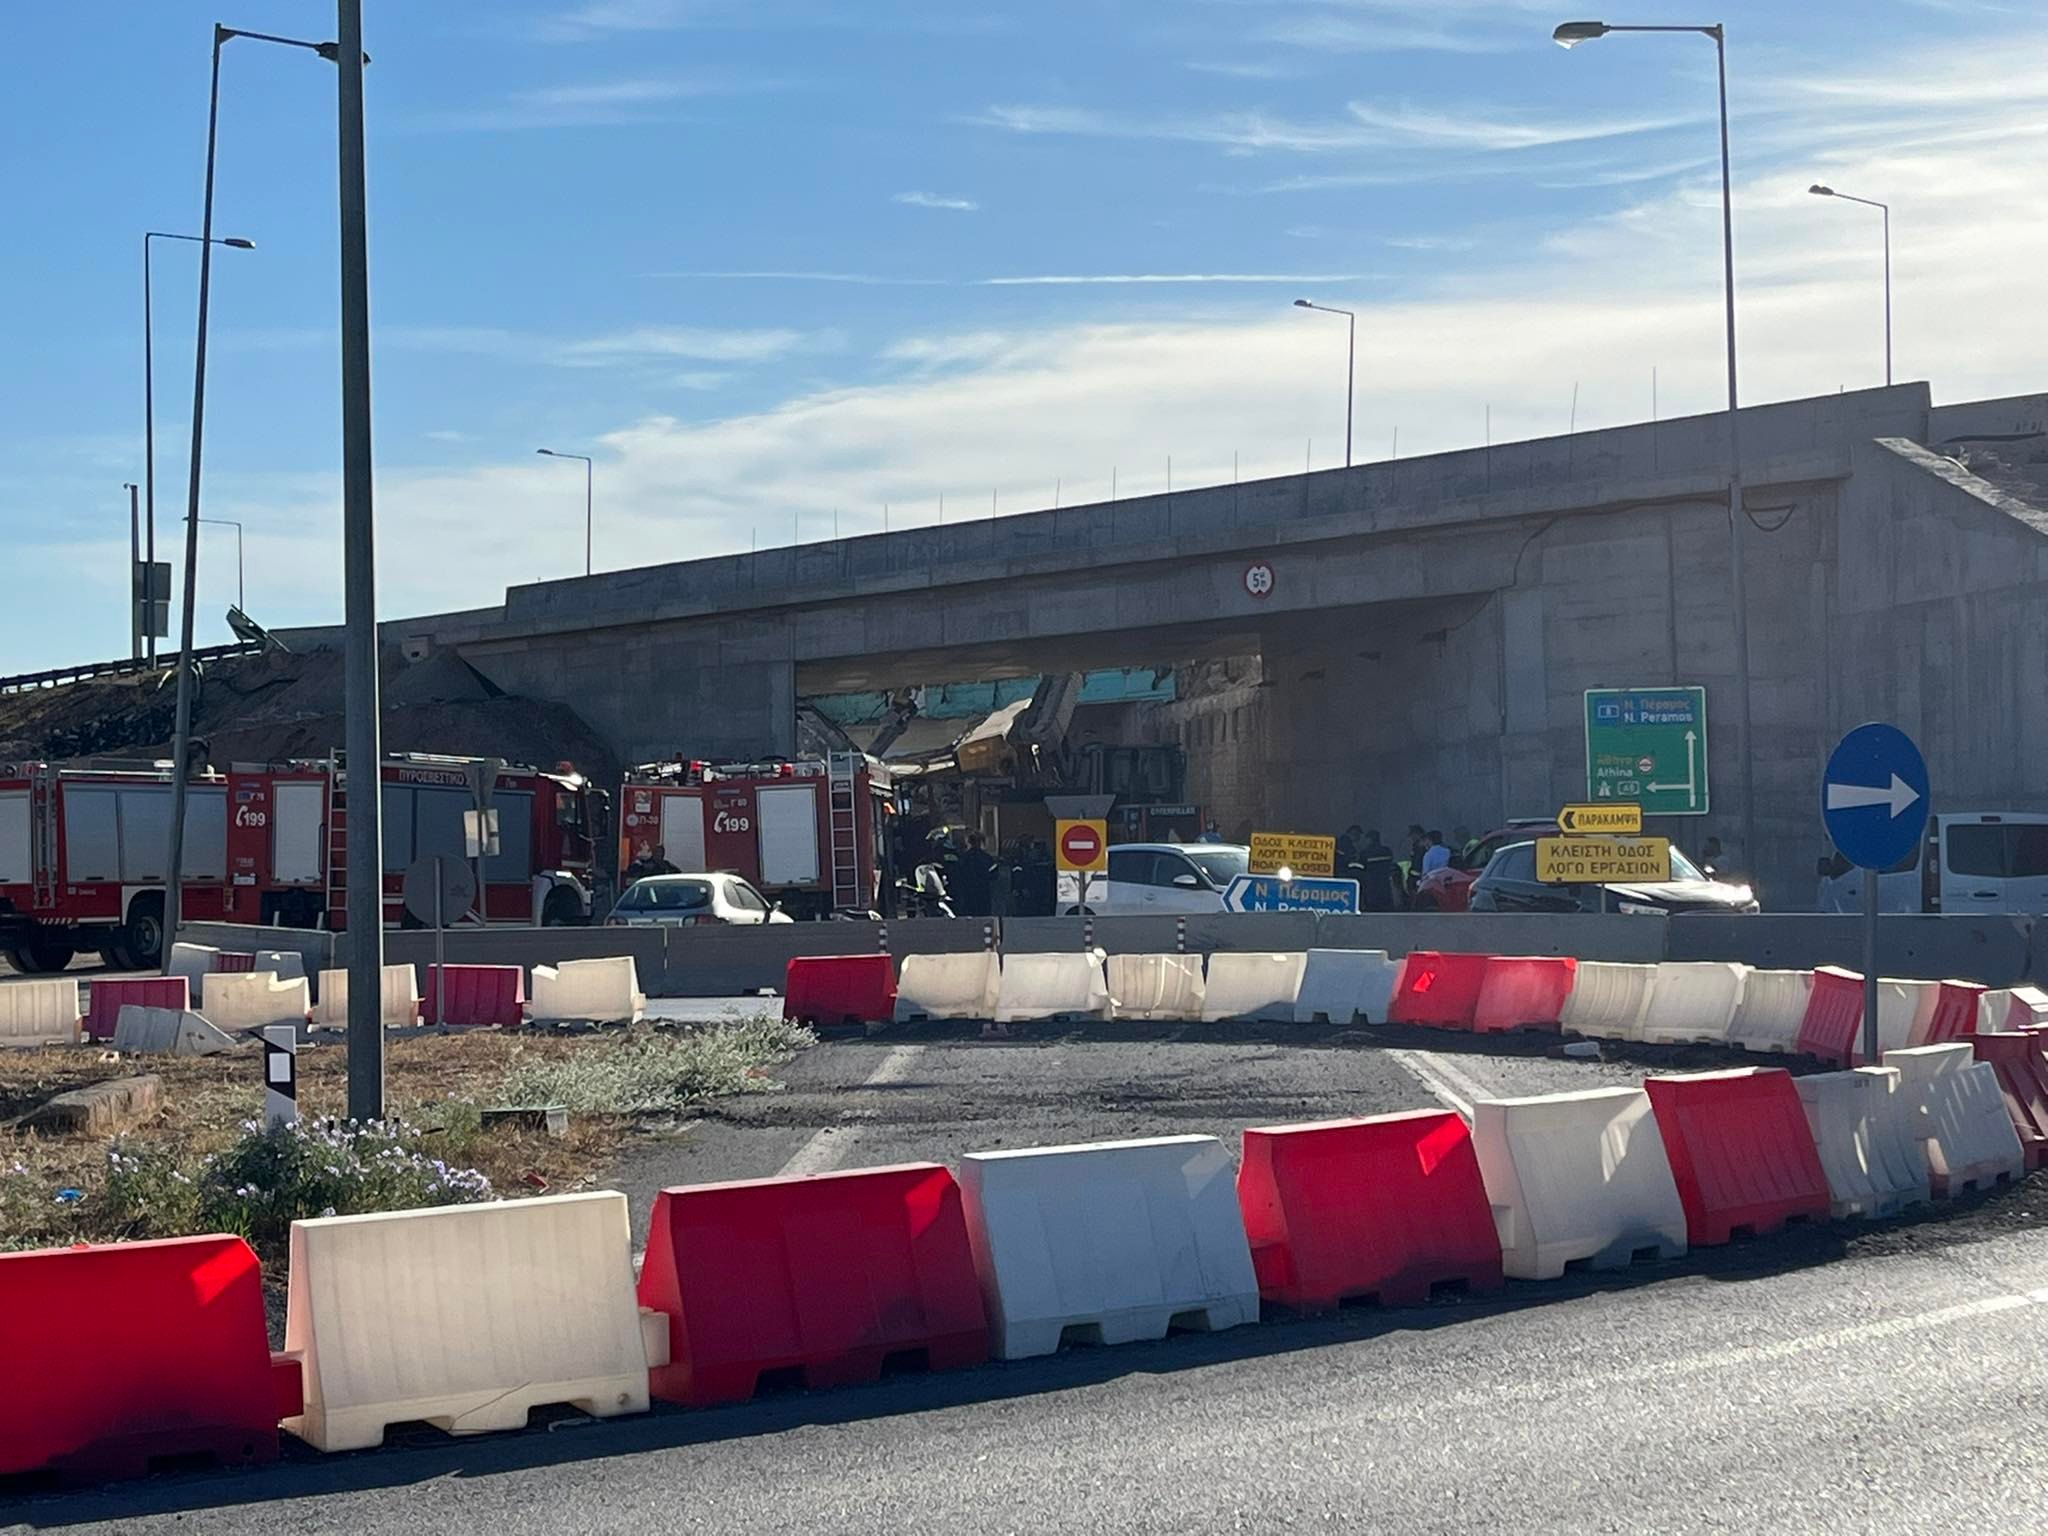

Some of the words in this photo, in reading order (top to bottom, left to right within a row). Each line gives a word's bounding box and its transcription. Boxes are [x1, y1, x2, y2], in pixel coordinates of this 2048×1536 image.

[1640, 711, 1694, 723] Peramos
[1597, 767, 1633, 778] Athina
[243, 811, 266, 827] 199
[723, 817, 750, 832] 199
[1578, 812, 1638, 826] ΠΑΡΑΚΑΜΨΗ
[1253, 837, 1283, 848] ΟΔΟΣ
[1289, 839, 1333, 850] ΚΛΕΙΣΤΗ
[1257, 848, 1287, 859] ΛΟΓΩ
[1292, 850, 1328, 861] ΕΡΓΩΝ
[1551, 844, 1611, 858] ΚΛΕΙΣΤΗ
[1617, 844, 1655, 858] ΟΔΟΣ
[1547, 861, 1585, 875] ΛΟΓΩ
[1590, 861, 1661, 875] ΕΡΓΑΣΙΩΝ
[1279, 882, 1350, 906] Πέραμος
